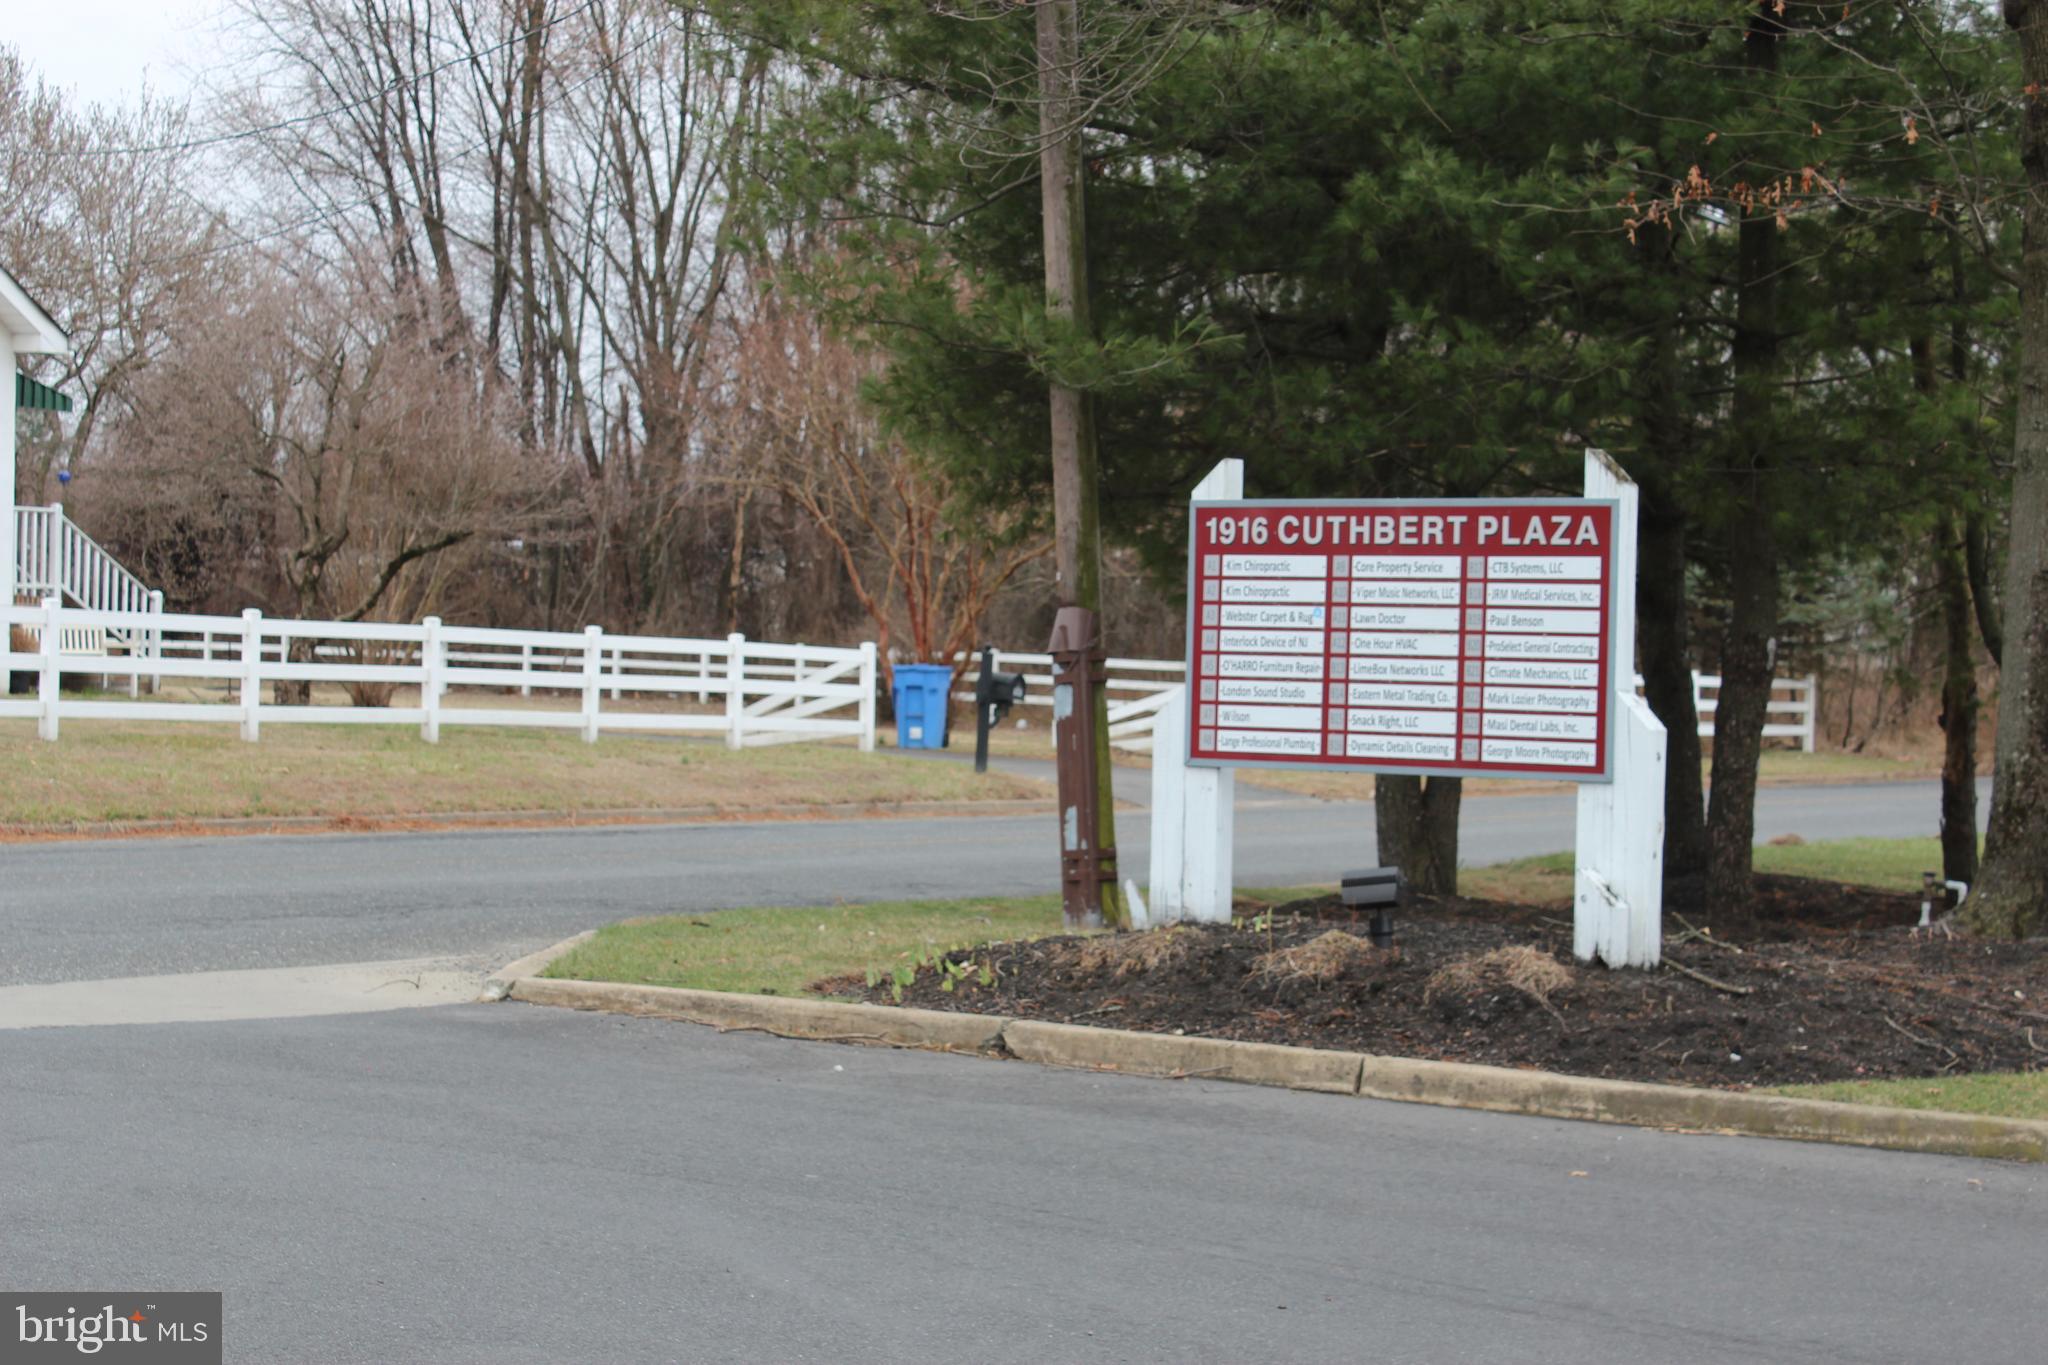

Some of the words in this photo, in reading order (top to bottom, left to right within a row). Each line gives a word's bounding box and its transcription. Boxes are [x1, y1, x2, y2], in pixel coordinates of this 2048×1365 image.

[1206, 516, 1269, 544] 1916
[1277, 515, 1468, 545] CUTHBERT
[1477, 515, 1600, 546] PLAZA
[1226, 561, 1241, 572] Kim
[1244, 561, 1291, 574] Chiropractic
[1355, 561, 1374, 573] Core
[1376, 561, 1412, 575] Property
[1413, 561, 1443, 573] Service
[1511, 562, 1547, 576] Systems,
[1549, 562, 1564, 574] LLC
[1225, 586, 1241, 597] Kim
[1243, 586, 1290, 600] Chiropractic
[1379, 587, 1401, 599] Music
[1402, 588, 1440, 601] Networks,
[1442, 588, 1454, 600] LLC
[1511, 588, 1542, 601] Medical
[1544, 589, 1578, 602] Services,
[1225, 611, 1258, 623] Webster
[1260, 611, 1288, 625] Carpet
[1289, 611, 1296, 622] &
[1299, 612, 1314, 625] Rug
[1355, 613, 1376, 624] Lawn
[1378, 613, 1406, 624] Doctor
[1490, 615, 1509, 627] Paul
[1511, 615, 1544, 628] Benson
[1223, 635, 1258, 647] Interlock
[1260, 636, 1286, 648] Device
[1288, 636, 1297, 648] of
[1355, 637, 1371, 650] One
[1373, 638, 1394, 650] Hour
[1395, 639, 1419, 651] HVAC
[1488, 640, 1522, 653] ProSelect
[1524, 642, 1551, 655] General
[1552, 642, 1594, 657] Contracting
[1259, 661, 1294, 672] Furniture
[1295, 662, 1320, 675] Repair
[1354, 663, 1388, 676] LimeBox
[1390, 664, 1429, 677] Networks
[1430, 665, 1445, 677] LLC
[1489, 666, 1521, 678] Climate
[1523, 667, 1571, 682] Mechanics,
[1573, 668, 1589, 681] LLC
[1222, 686, 1251, 697] London
[1253, 686, 1277, 698] Sound
[1280, 687, 1305, 699] Studio
[1353, 688, 1381, 701] Eastern
[1383, 689, 1405, 702] Metal
[1407, 690, 1436, 704] Trading
[1487, 693, 1509, 706] Mark
[1537, 694, 1590, 709] Photography
[1223, 711, 1250, 722] Wilson
[1352, 715, 1376, 726] Snack
[1378, 716, 1402, 730] Right,
[1404, 717, 1419, 728] LLC
[1510, 720, 1537, 733] Dental
[1540, 722, 1561, 735] Labs,
[1563, 722, 1579, 734] Inc.
[1242, 736, 1282, 749] Professional
[1283, 739, 1316, 752] Plumbing
[1351, 740, 1385, 755] Dynamic
[1387, 742, 1414, 754] Details
[1415, 742, 1449, 758] Cleaning
[1486, 745, 1513, 760] George
[1515, 747, 1540, 760] Moore
[1542, 748, 1590, 763] Photography
